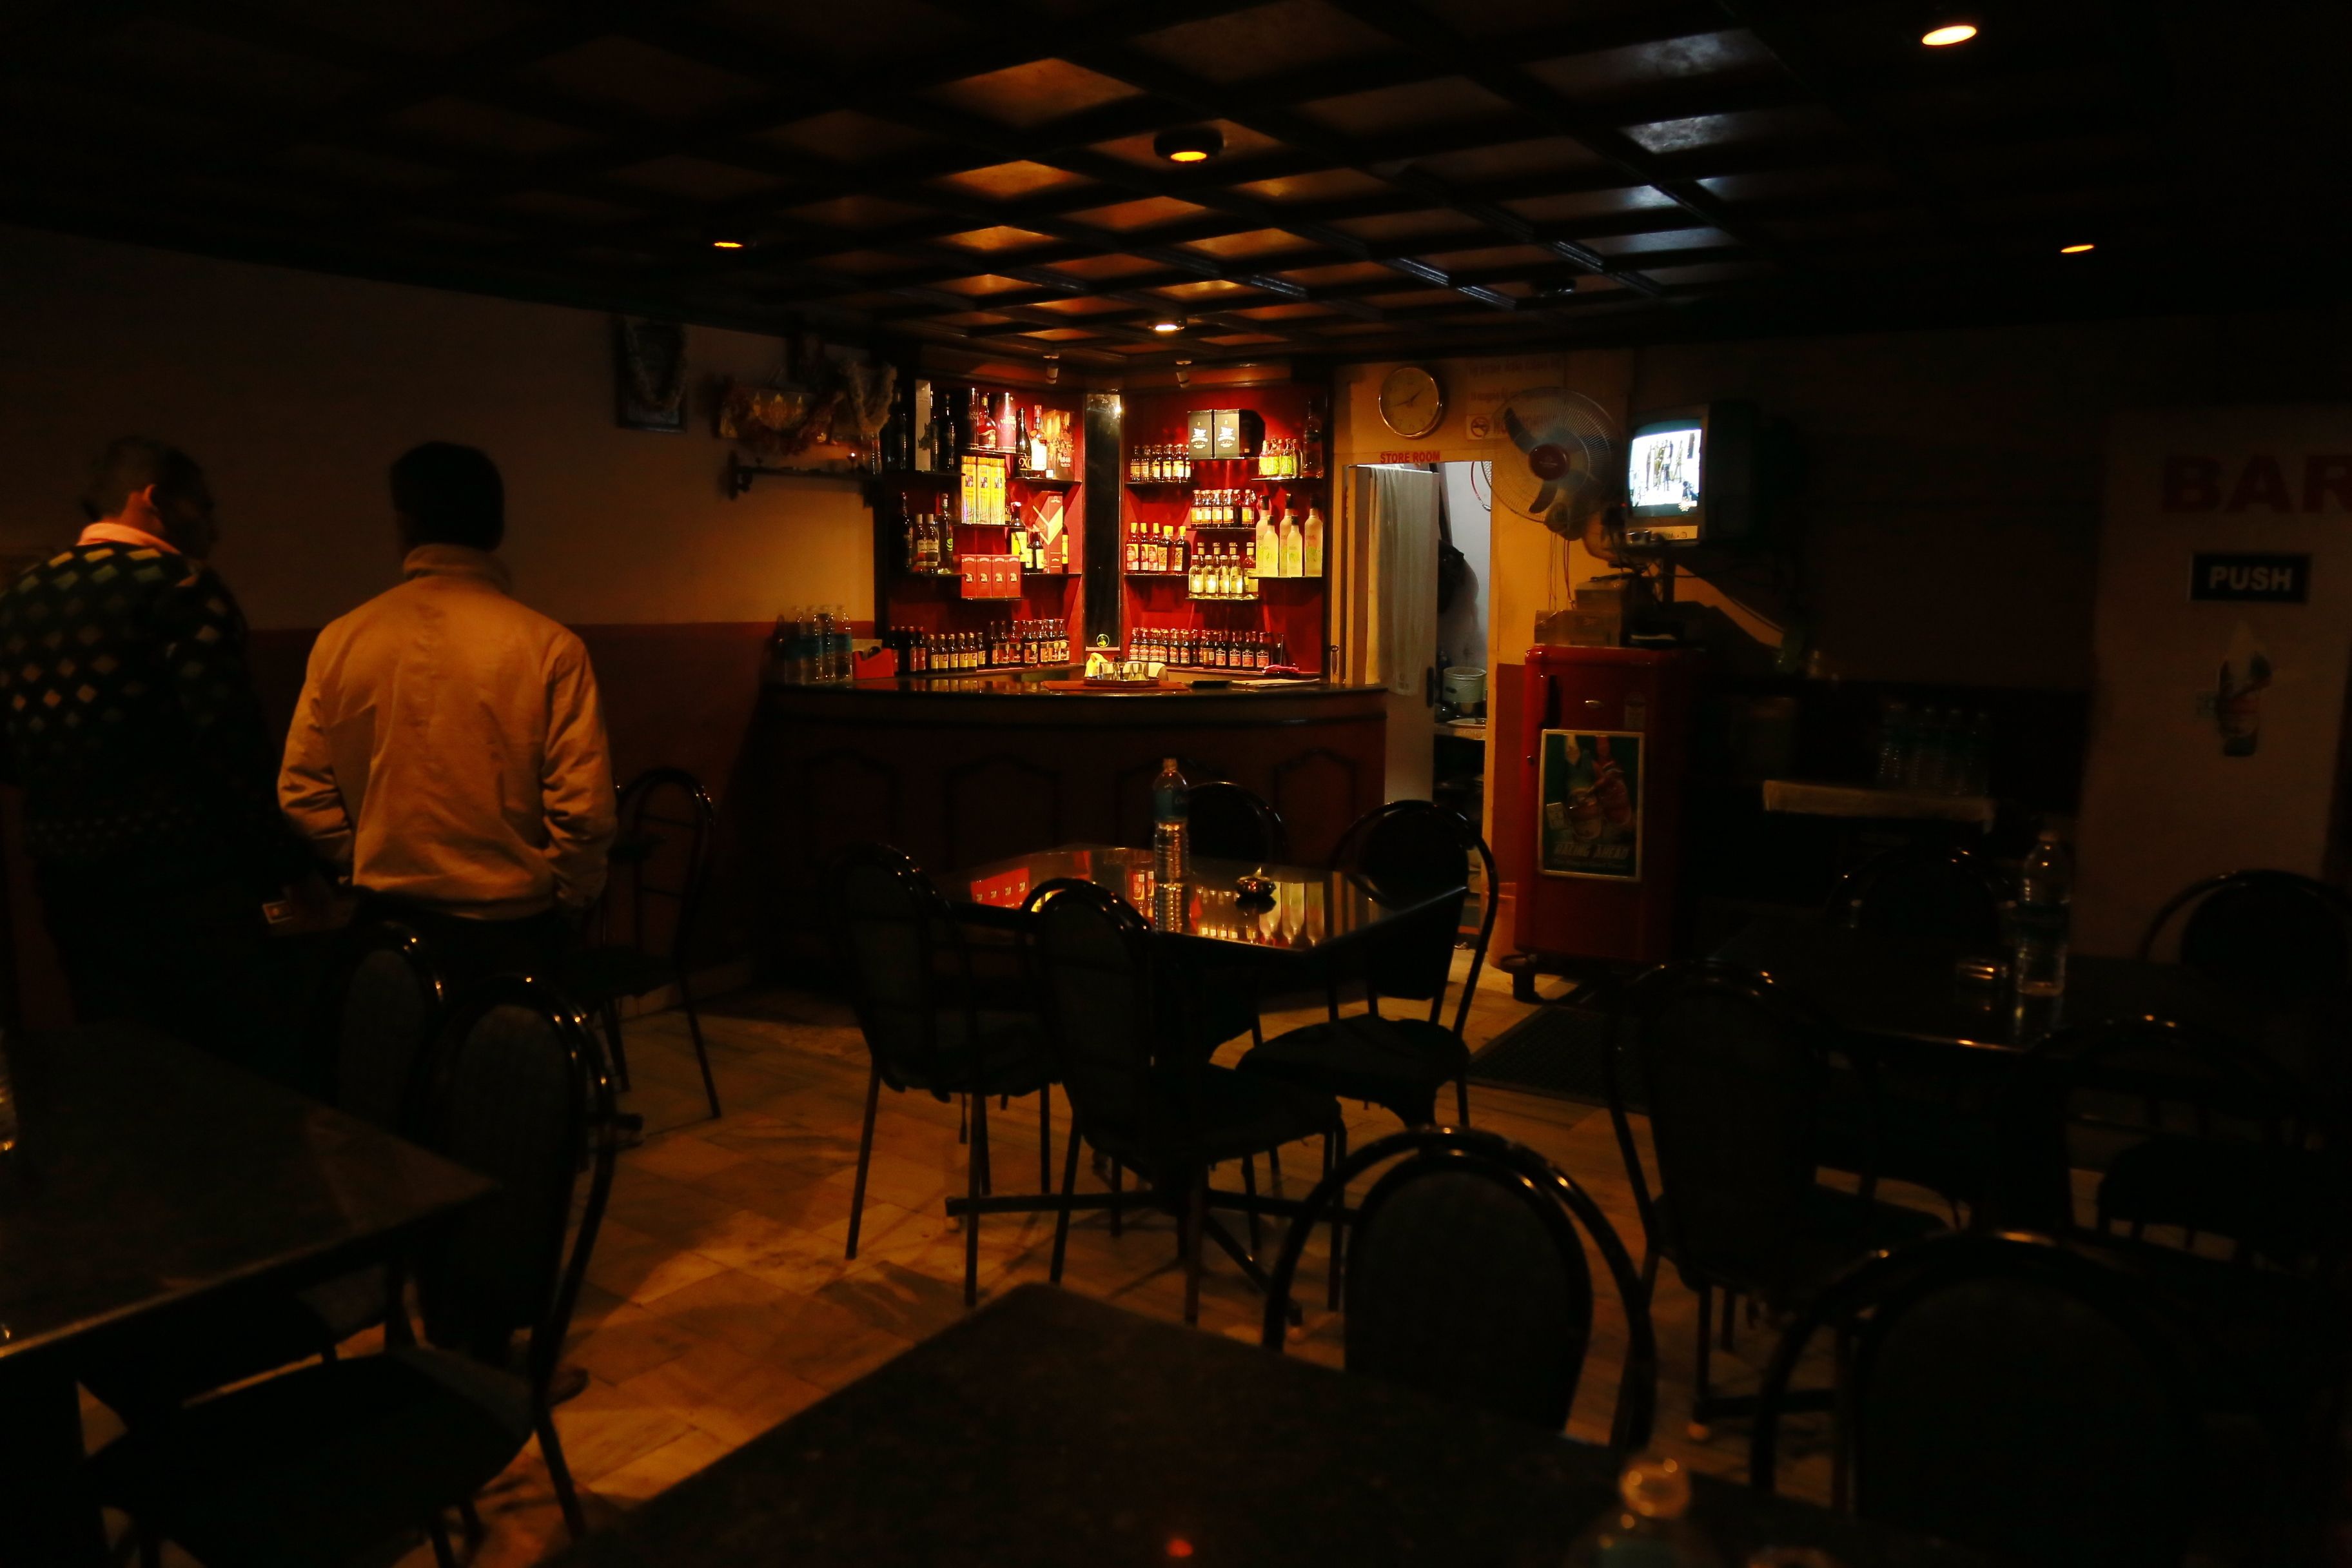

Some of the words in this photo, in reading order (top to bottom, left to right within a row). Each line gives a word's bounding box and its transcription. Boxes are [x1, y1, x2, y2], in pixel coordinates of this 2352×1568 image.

[1380, 453, 1410, 464] STORE
[1413, 452, 1441, 463] ROOM
[2162, 455, 2352, 513] BAR
[2208, 565, 2293, 591] PUSH
